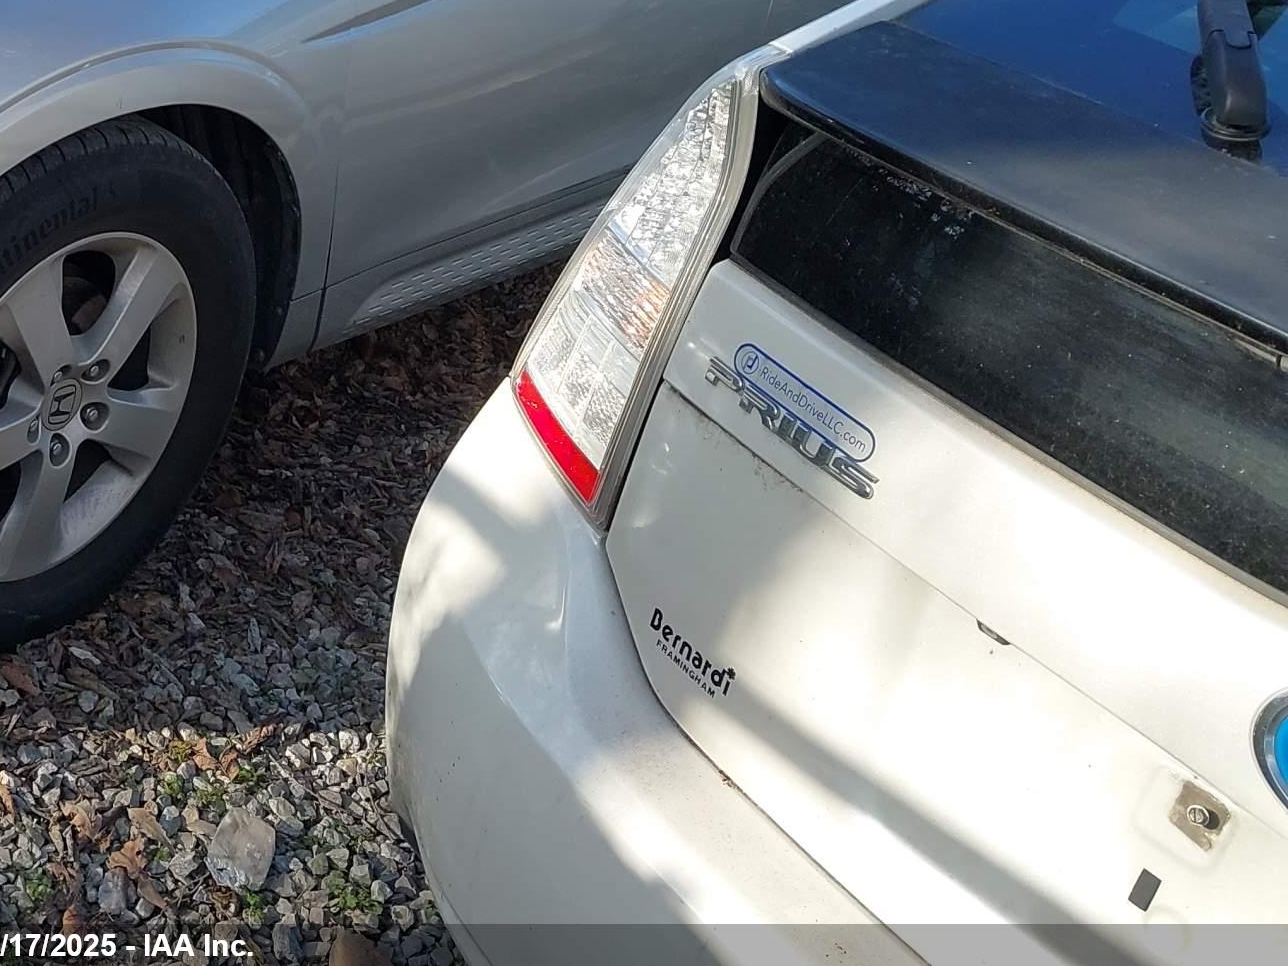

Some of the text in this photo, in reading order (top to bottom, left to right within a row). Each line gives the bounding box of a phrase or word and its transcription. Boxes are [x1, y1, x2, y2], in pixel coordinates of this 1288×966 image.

[704, 355, 880, 500] PRIUS
[759, 367, 867, 452] RideAndDriveLLC.com
[649, 607, 736, 696] Bernardi
[656, 639, 716, 698] FRAMINGHAM
